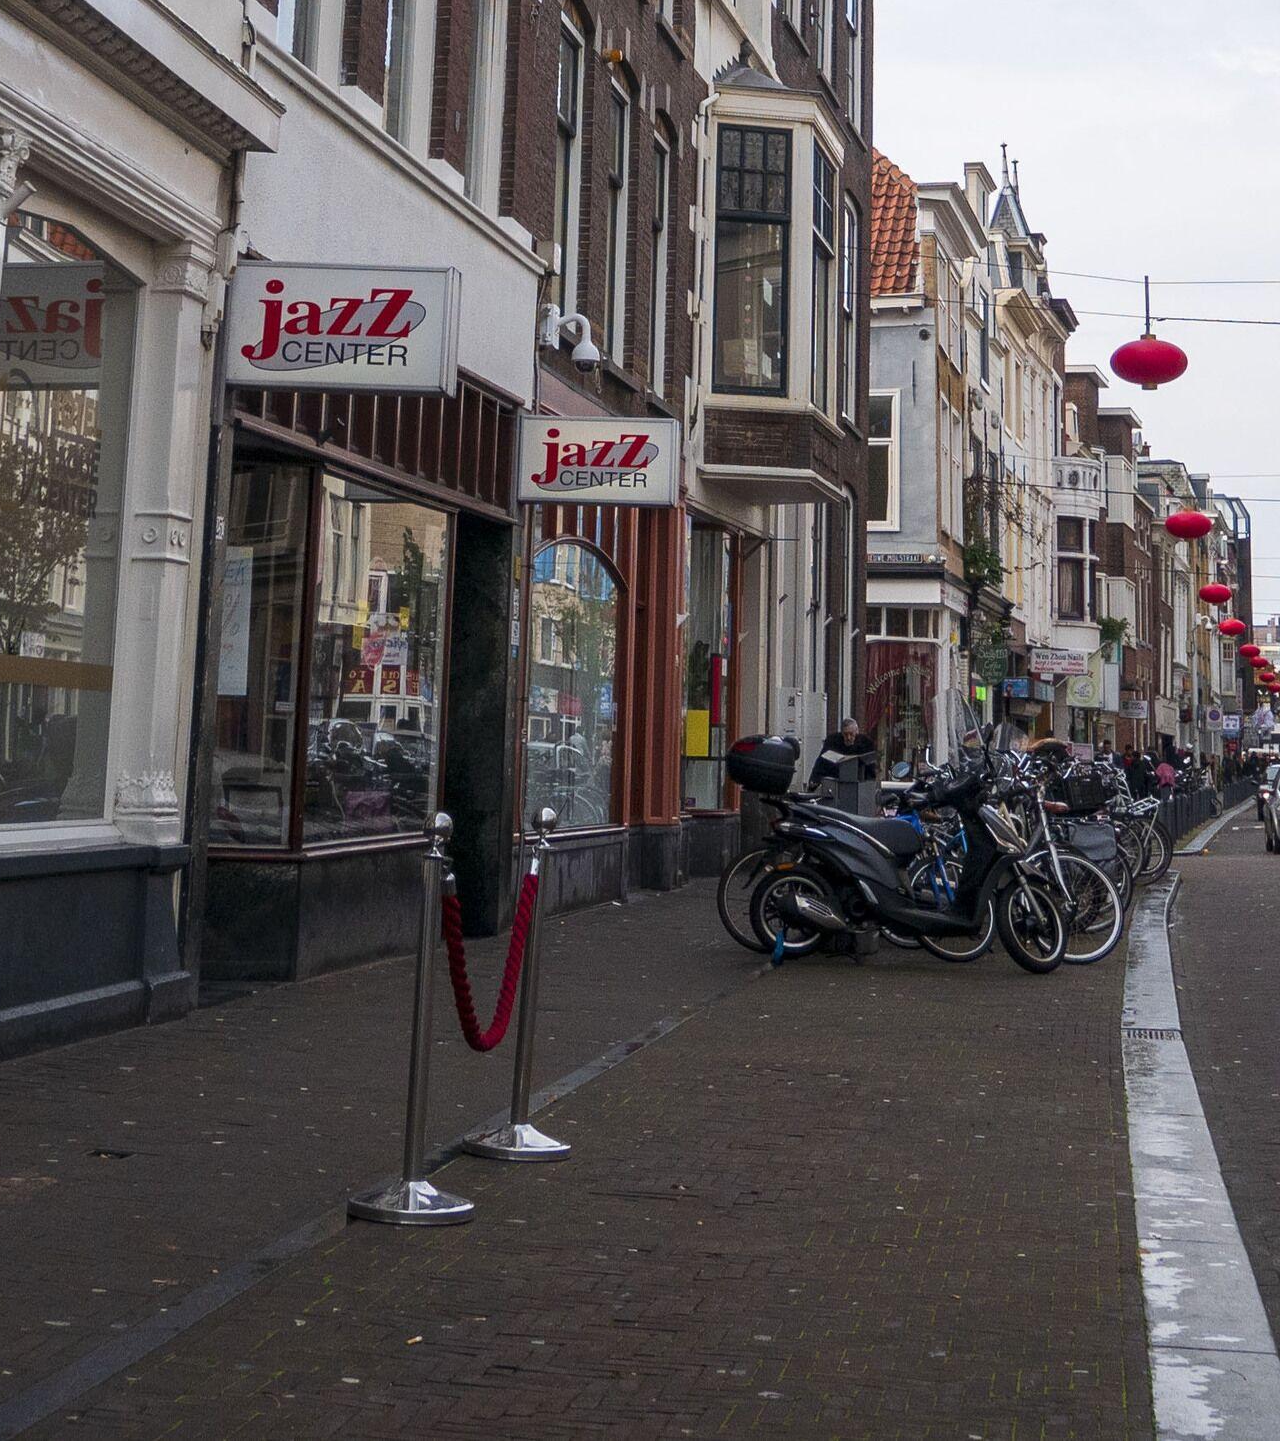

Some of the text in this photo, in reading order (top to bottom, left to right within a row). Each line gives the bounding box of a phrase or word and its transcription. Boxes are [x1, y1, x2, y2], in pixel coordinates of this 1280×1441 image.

[282, 340, 408, 367] CENTER
[560, 470, 648, 488] CENTER
[866, 667, 900, 696] Welcome
